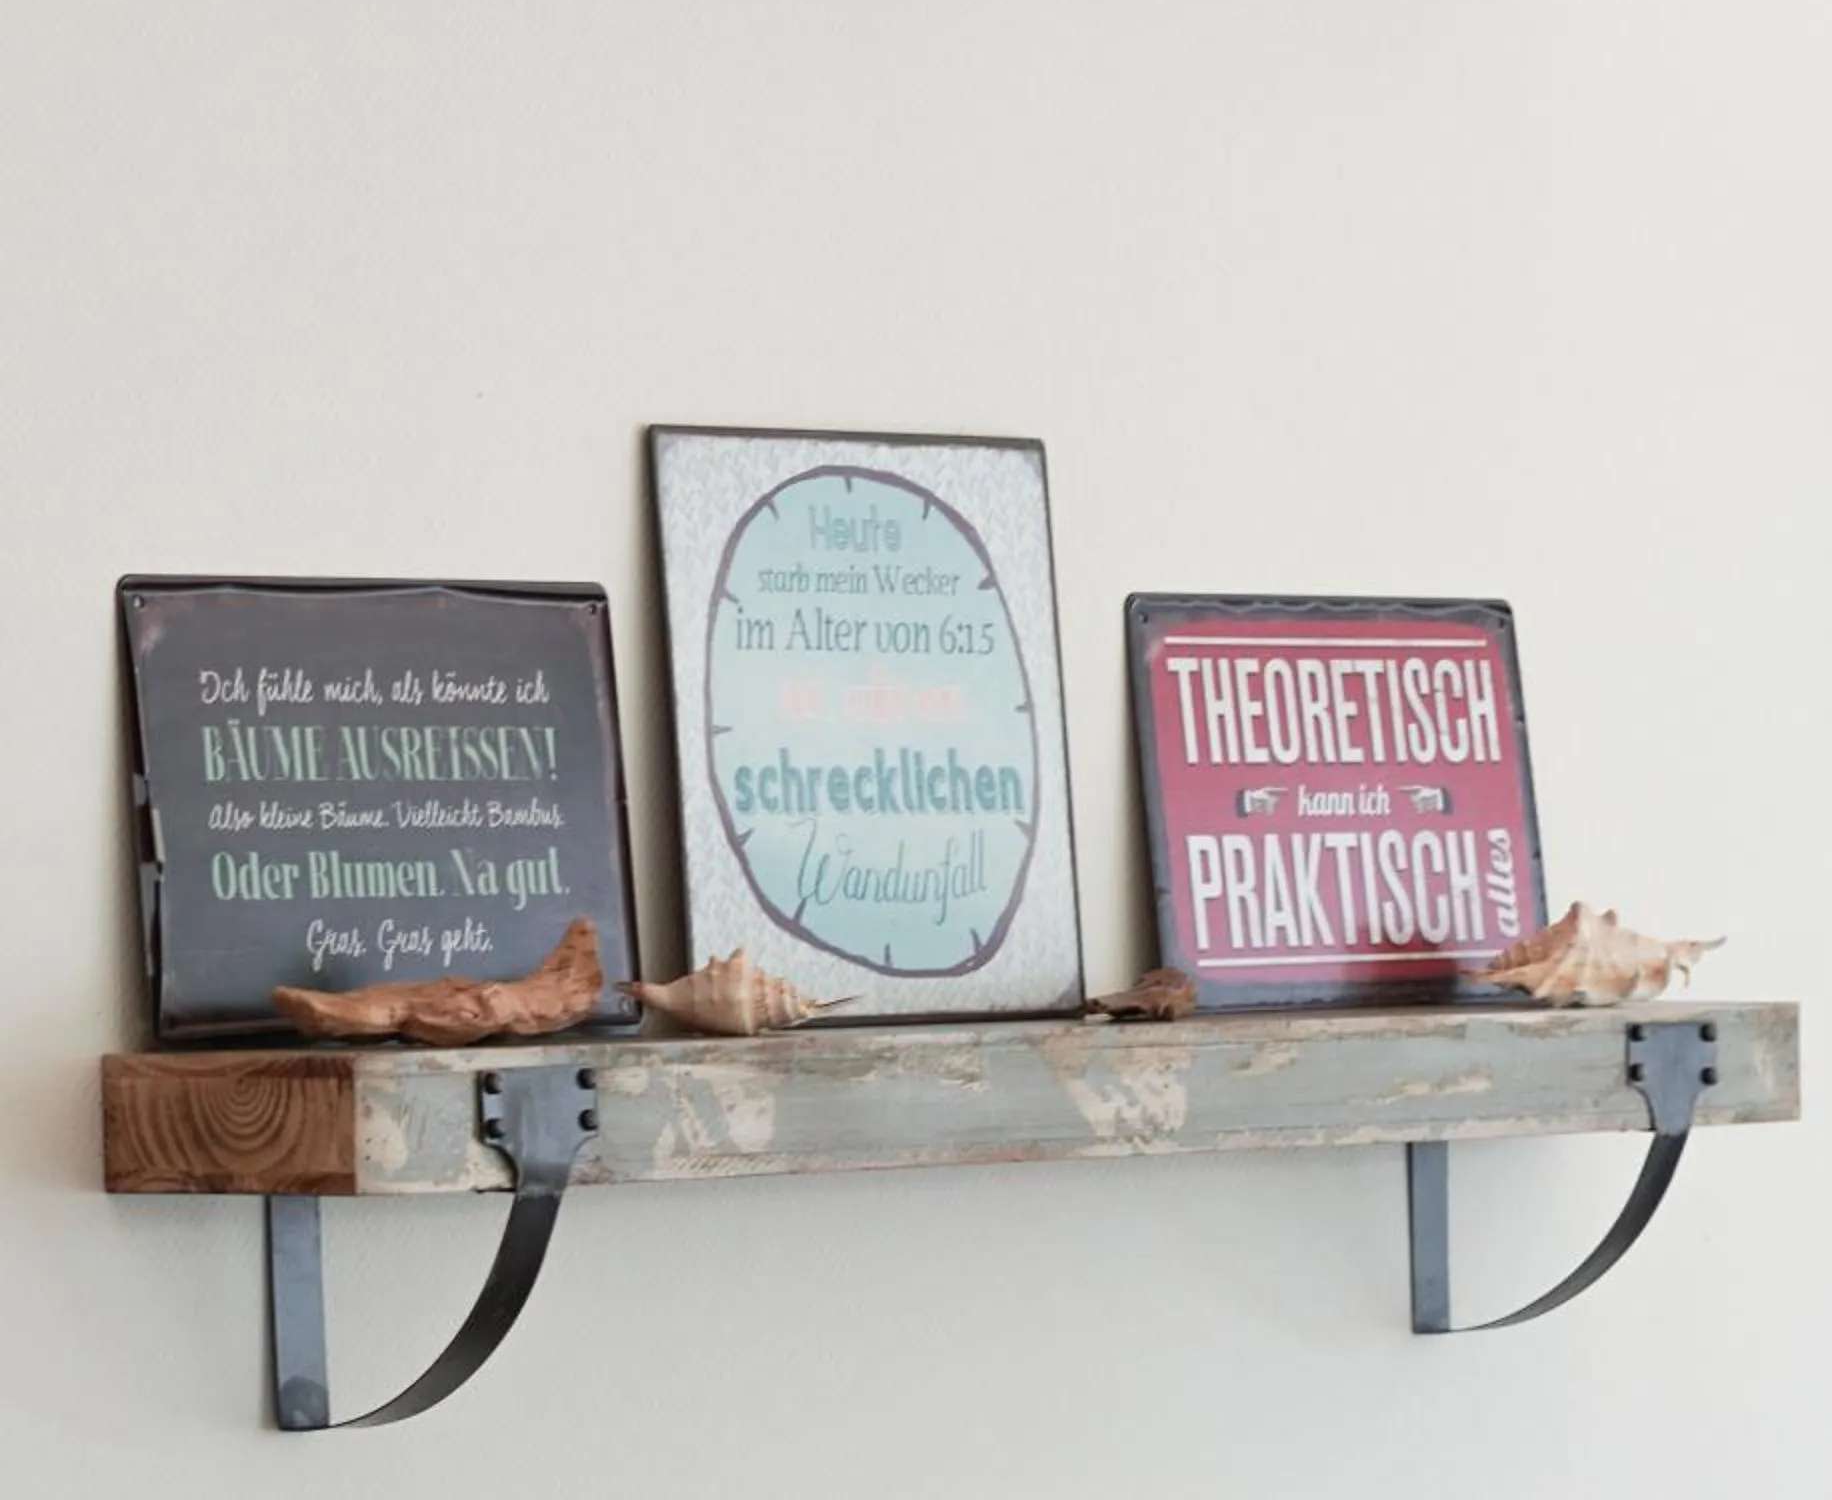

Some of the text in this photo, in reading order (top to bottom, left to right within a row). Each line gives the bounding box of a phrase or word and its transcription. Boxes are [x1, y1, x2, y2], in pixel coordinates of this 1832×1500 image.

[809, 504, 902, 553] Heute
[758, 563, 962, 597] starb mein Wecker
[735, 607, 995, 656] im Alter von 6:15
[257, 667, 313, 716] fühle
[323, 667, 384, 708] mich,
[391, 671, 424, 706] als
[431, 670, 507, 704] könnte
[515, 670, 550, 704] ich
[1167, 657, 1501, 765] THEORETISCH
[203, 719, 559, 781] BÄUME AUSREISSEN!
[733, 747, 1025, 815] schrecklichen
[1298, 784, 1391, 817] kann ich
[258, 801, 313, 830] kleine
[394, 800, 483, 830] Vielleicht
[211, 847, 572, 910] Oder Blumen. Na gut.
[786, 817, 988, 926] Wandunfall
[1186, 829, 1485, 950] PRAKTISCH
[1486, 828, 1521, 938] alles
[377, 918, 433, 970] Gras
[441, 917, 494, 967] geht.
